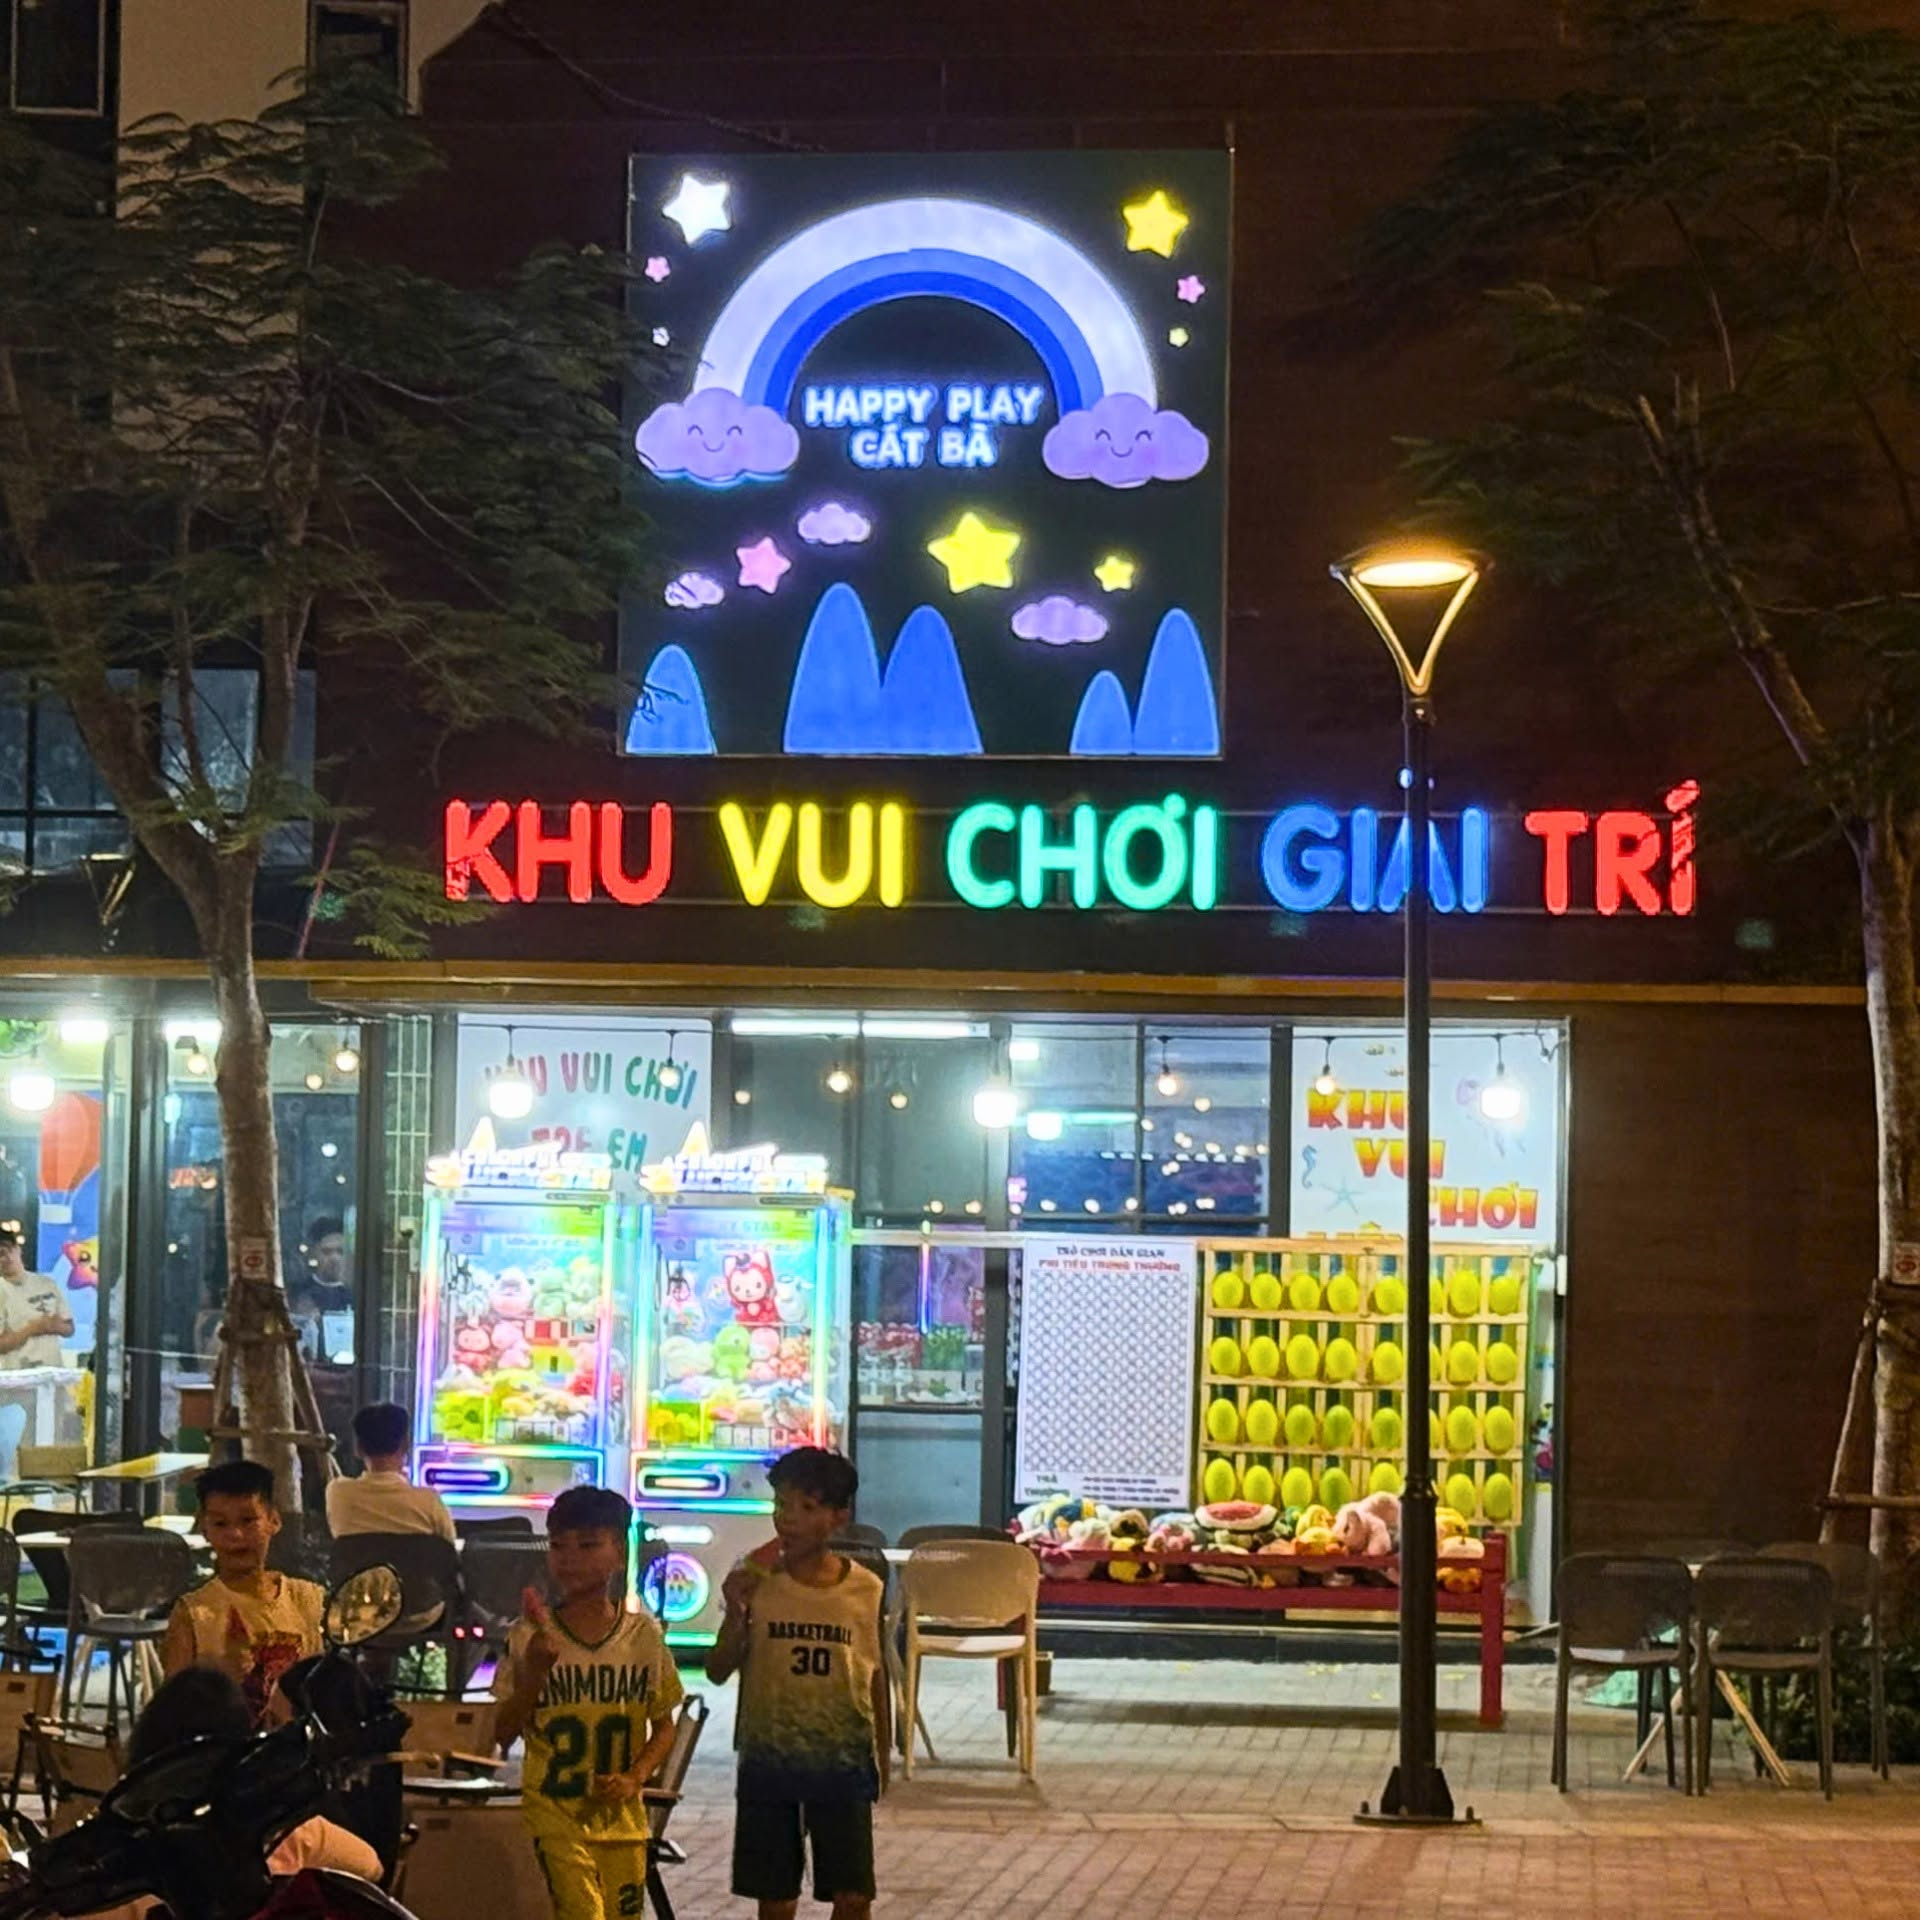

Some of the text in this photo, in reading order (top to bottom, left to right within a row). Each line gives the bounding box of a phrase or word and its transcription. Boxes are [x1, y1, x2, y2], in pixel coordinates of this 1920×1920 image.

[804, 384, 1044, 426] HAPPY PLAY
[850, 421, 926, 467] CÁT
[445, 800, 673, 904] KHU
[718, 802, 902, 908] VUI
[946, 793, 1217, 911] CHƠI
[1523, 778, 1700, 916] TRÍ
[560, 1051, 613, 1095] VUI
[624, 1055, 698, 1110] CHƠI
[607, 1126, 648, 1174] EM
[1429, 1180, 1539, 1230] HƠI
[767, 1621, 852, 1646] BASKETBALL
[790, 1645, 831, 1677] 30
[540, 1713, 633, 1799] 20
